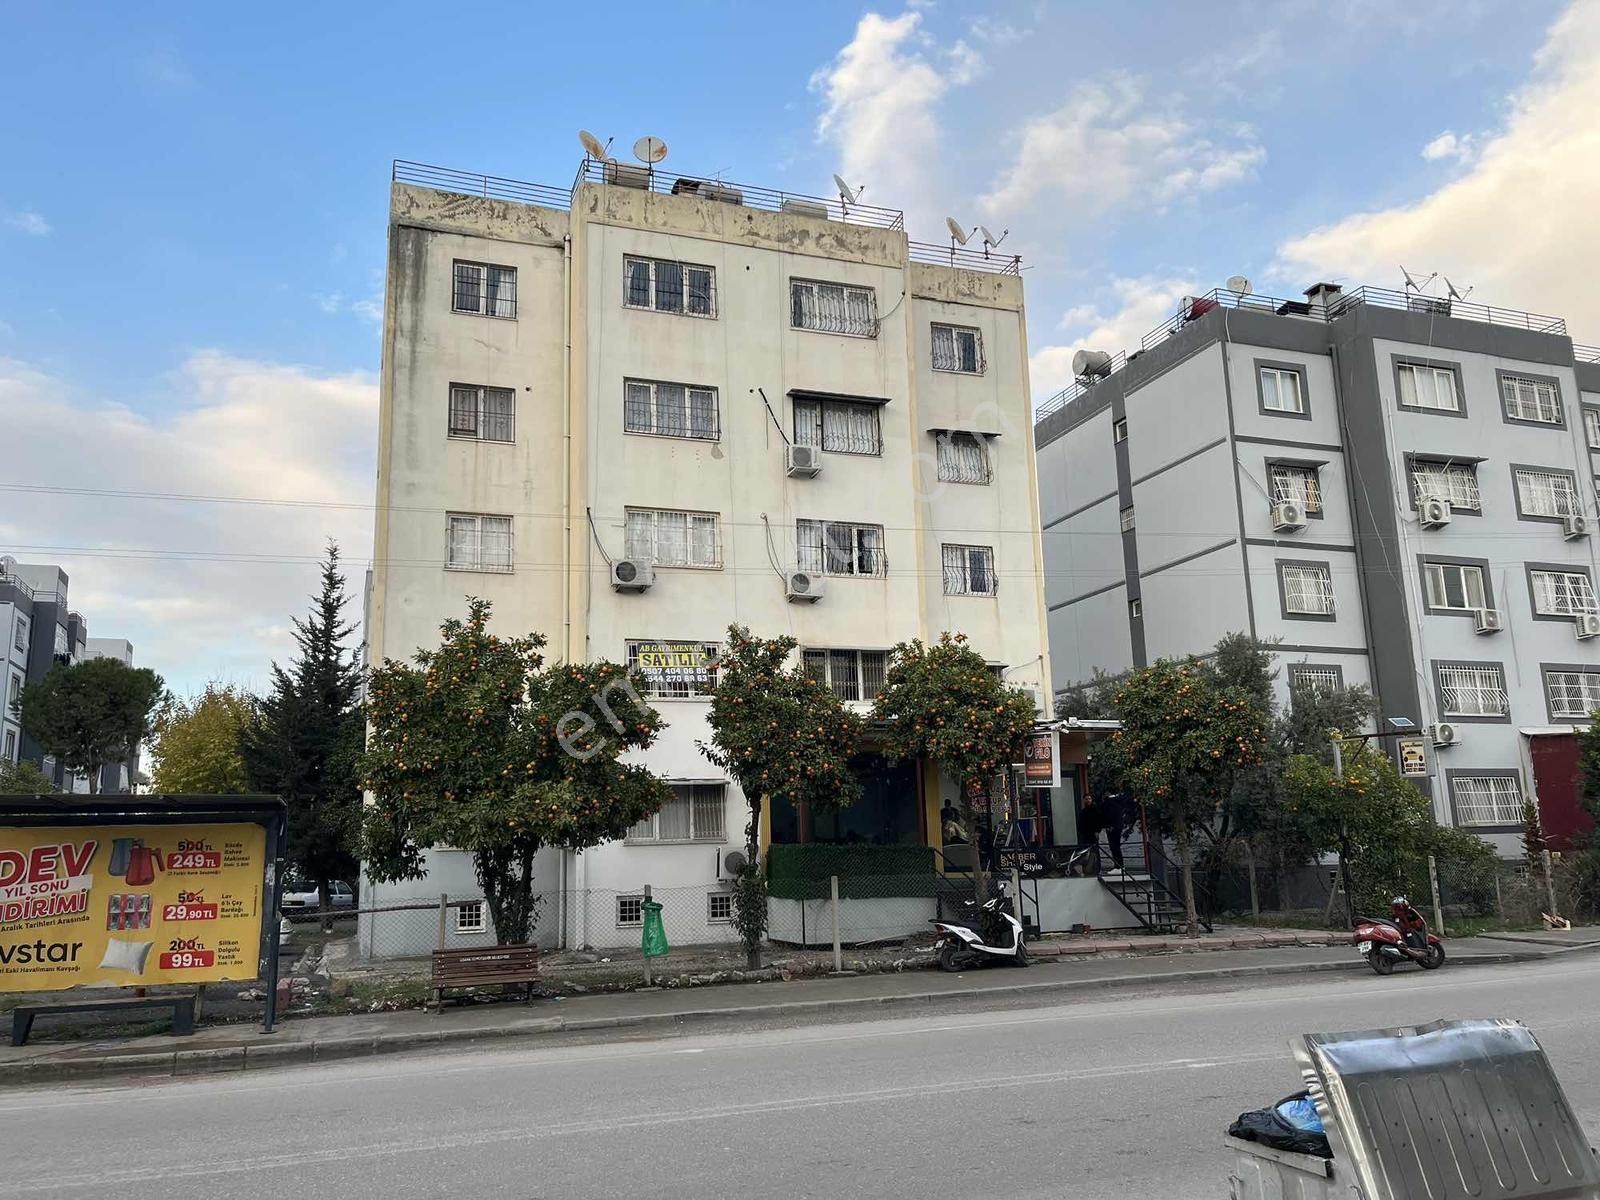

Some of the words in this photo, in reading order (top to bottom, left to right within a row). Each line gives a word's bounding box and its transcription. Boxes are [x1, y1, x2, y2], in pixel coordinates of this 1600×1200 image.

[639, 644, 650, 652] AB
[642, 654, 702, 666] SATILIK
[173, 855, 205, 868] 249
[206, 859, 216, 867] TL
[1000, 859, 1026, 867] SHP
[1023, 863, 1043, 871] Style
[5, 887, 26, 899] YIL
[30, 880, 70, 895] SONU
[166, 906, 202, 920] 29,90
[204, 910, 214, 918] TL
[1, 924, 23, 932] Aralık
[25, 919, 56, 929] Tarihleri
[57, 915, 90, 925] Arasında
[172, 954, 193, 967] 99
[194, 958, 204, 966] TL
